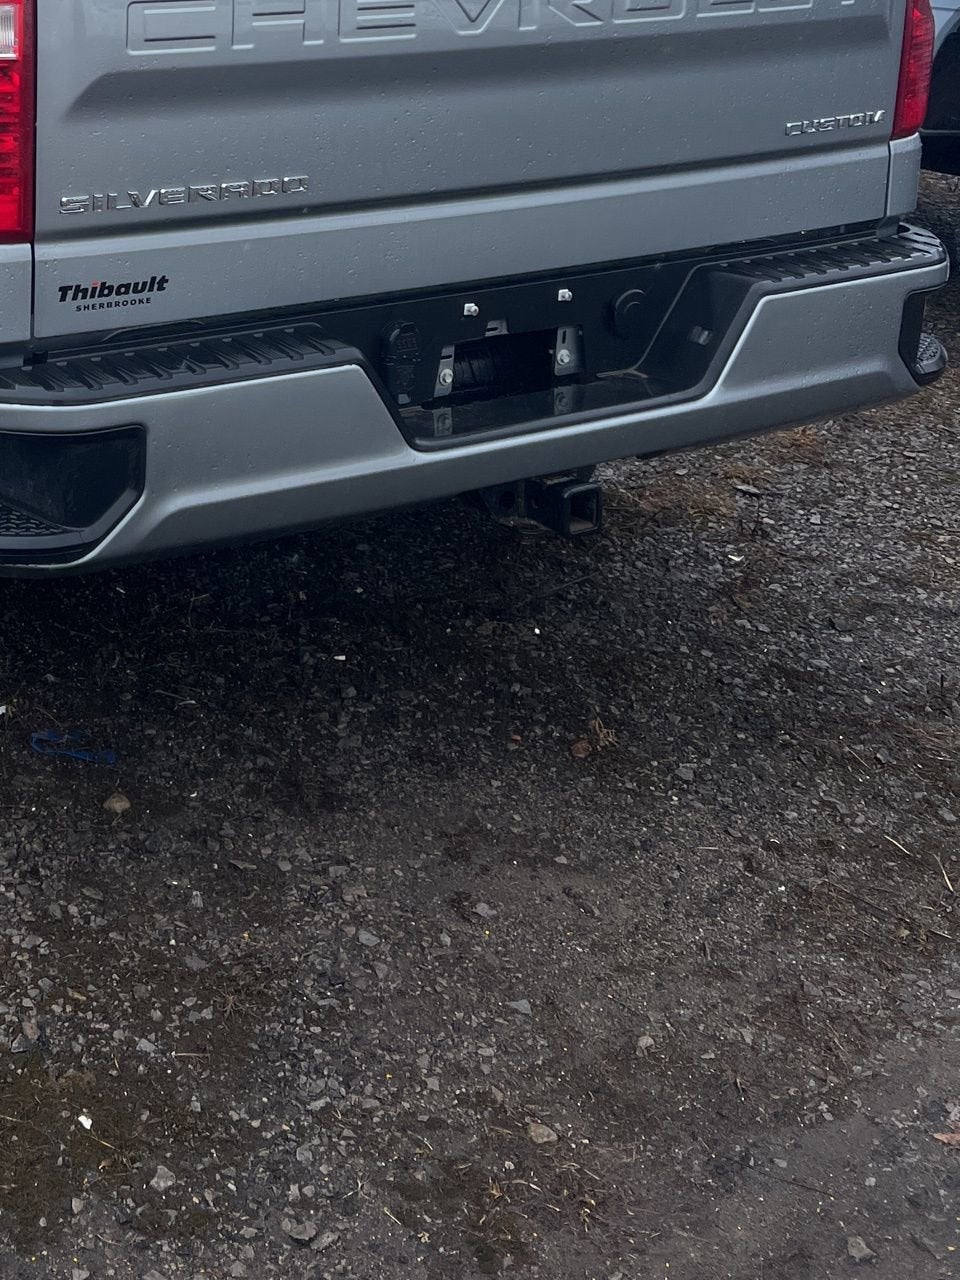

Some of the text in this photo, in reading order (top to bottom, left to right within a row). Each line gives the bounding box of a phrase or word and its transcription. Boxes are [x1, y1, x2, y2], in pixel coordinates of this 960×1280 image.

[784, 109, 886, 136] CUSTOM
[58, 175, 309, 215] SILVERADO
[58, 275, 169, 303] Thibault
[75, 297, 152, 312] SHERBROOKE
